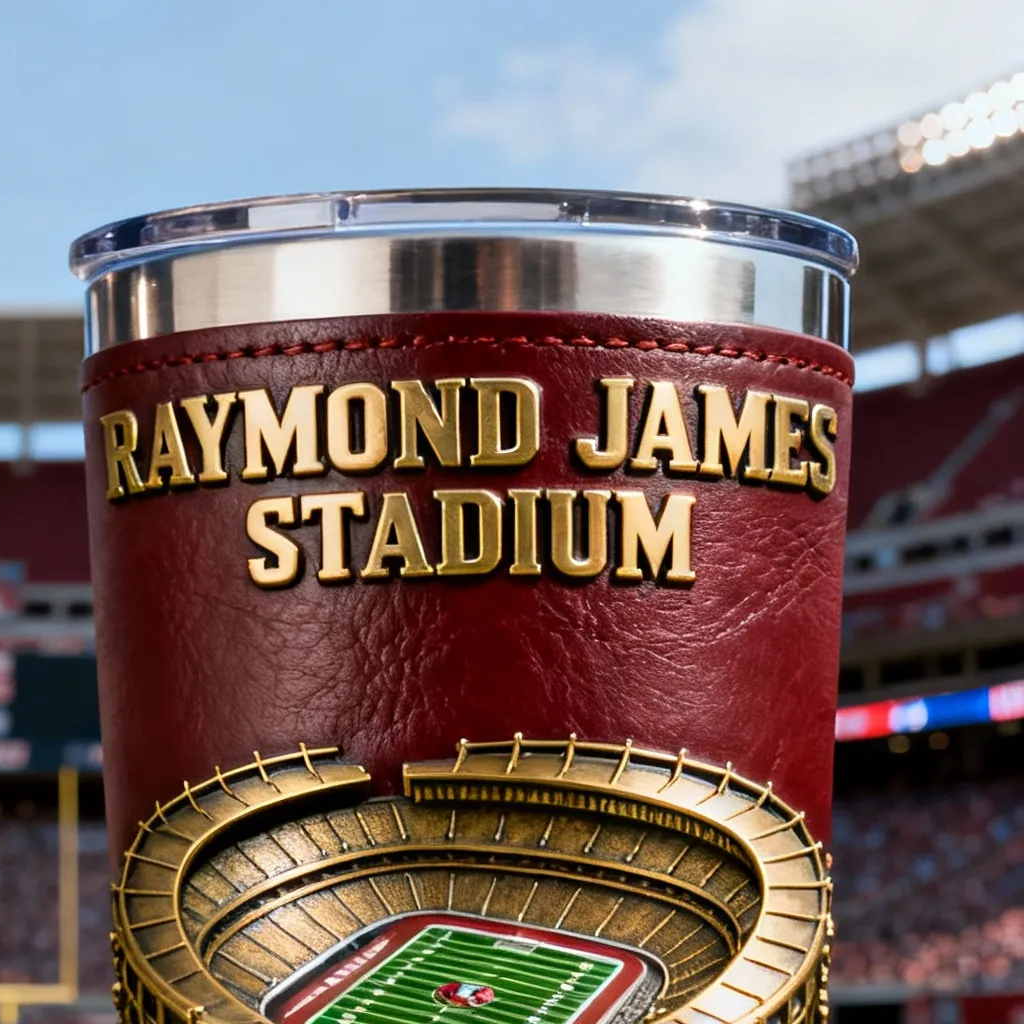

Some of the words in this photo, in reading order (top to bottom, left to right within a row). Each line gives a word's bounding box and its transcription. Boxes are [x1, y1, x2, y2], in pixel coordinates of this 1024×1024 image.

[100, 377, 542, 498] RAYMOND
[576, 378, 839, 496] JAMES
[246, 488, 697, 587] STADIUM
